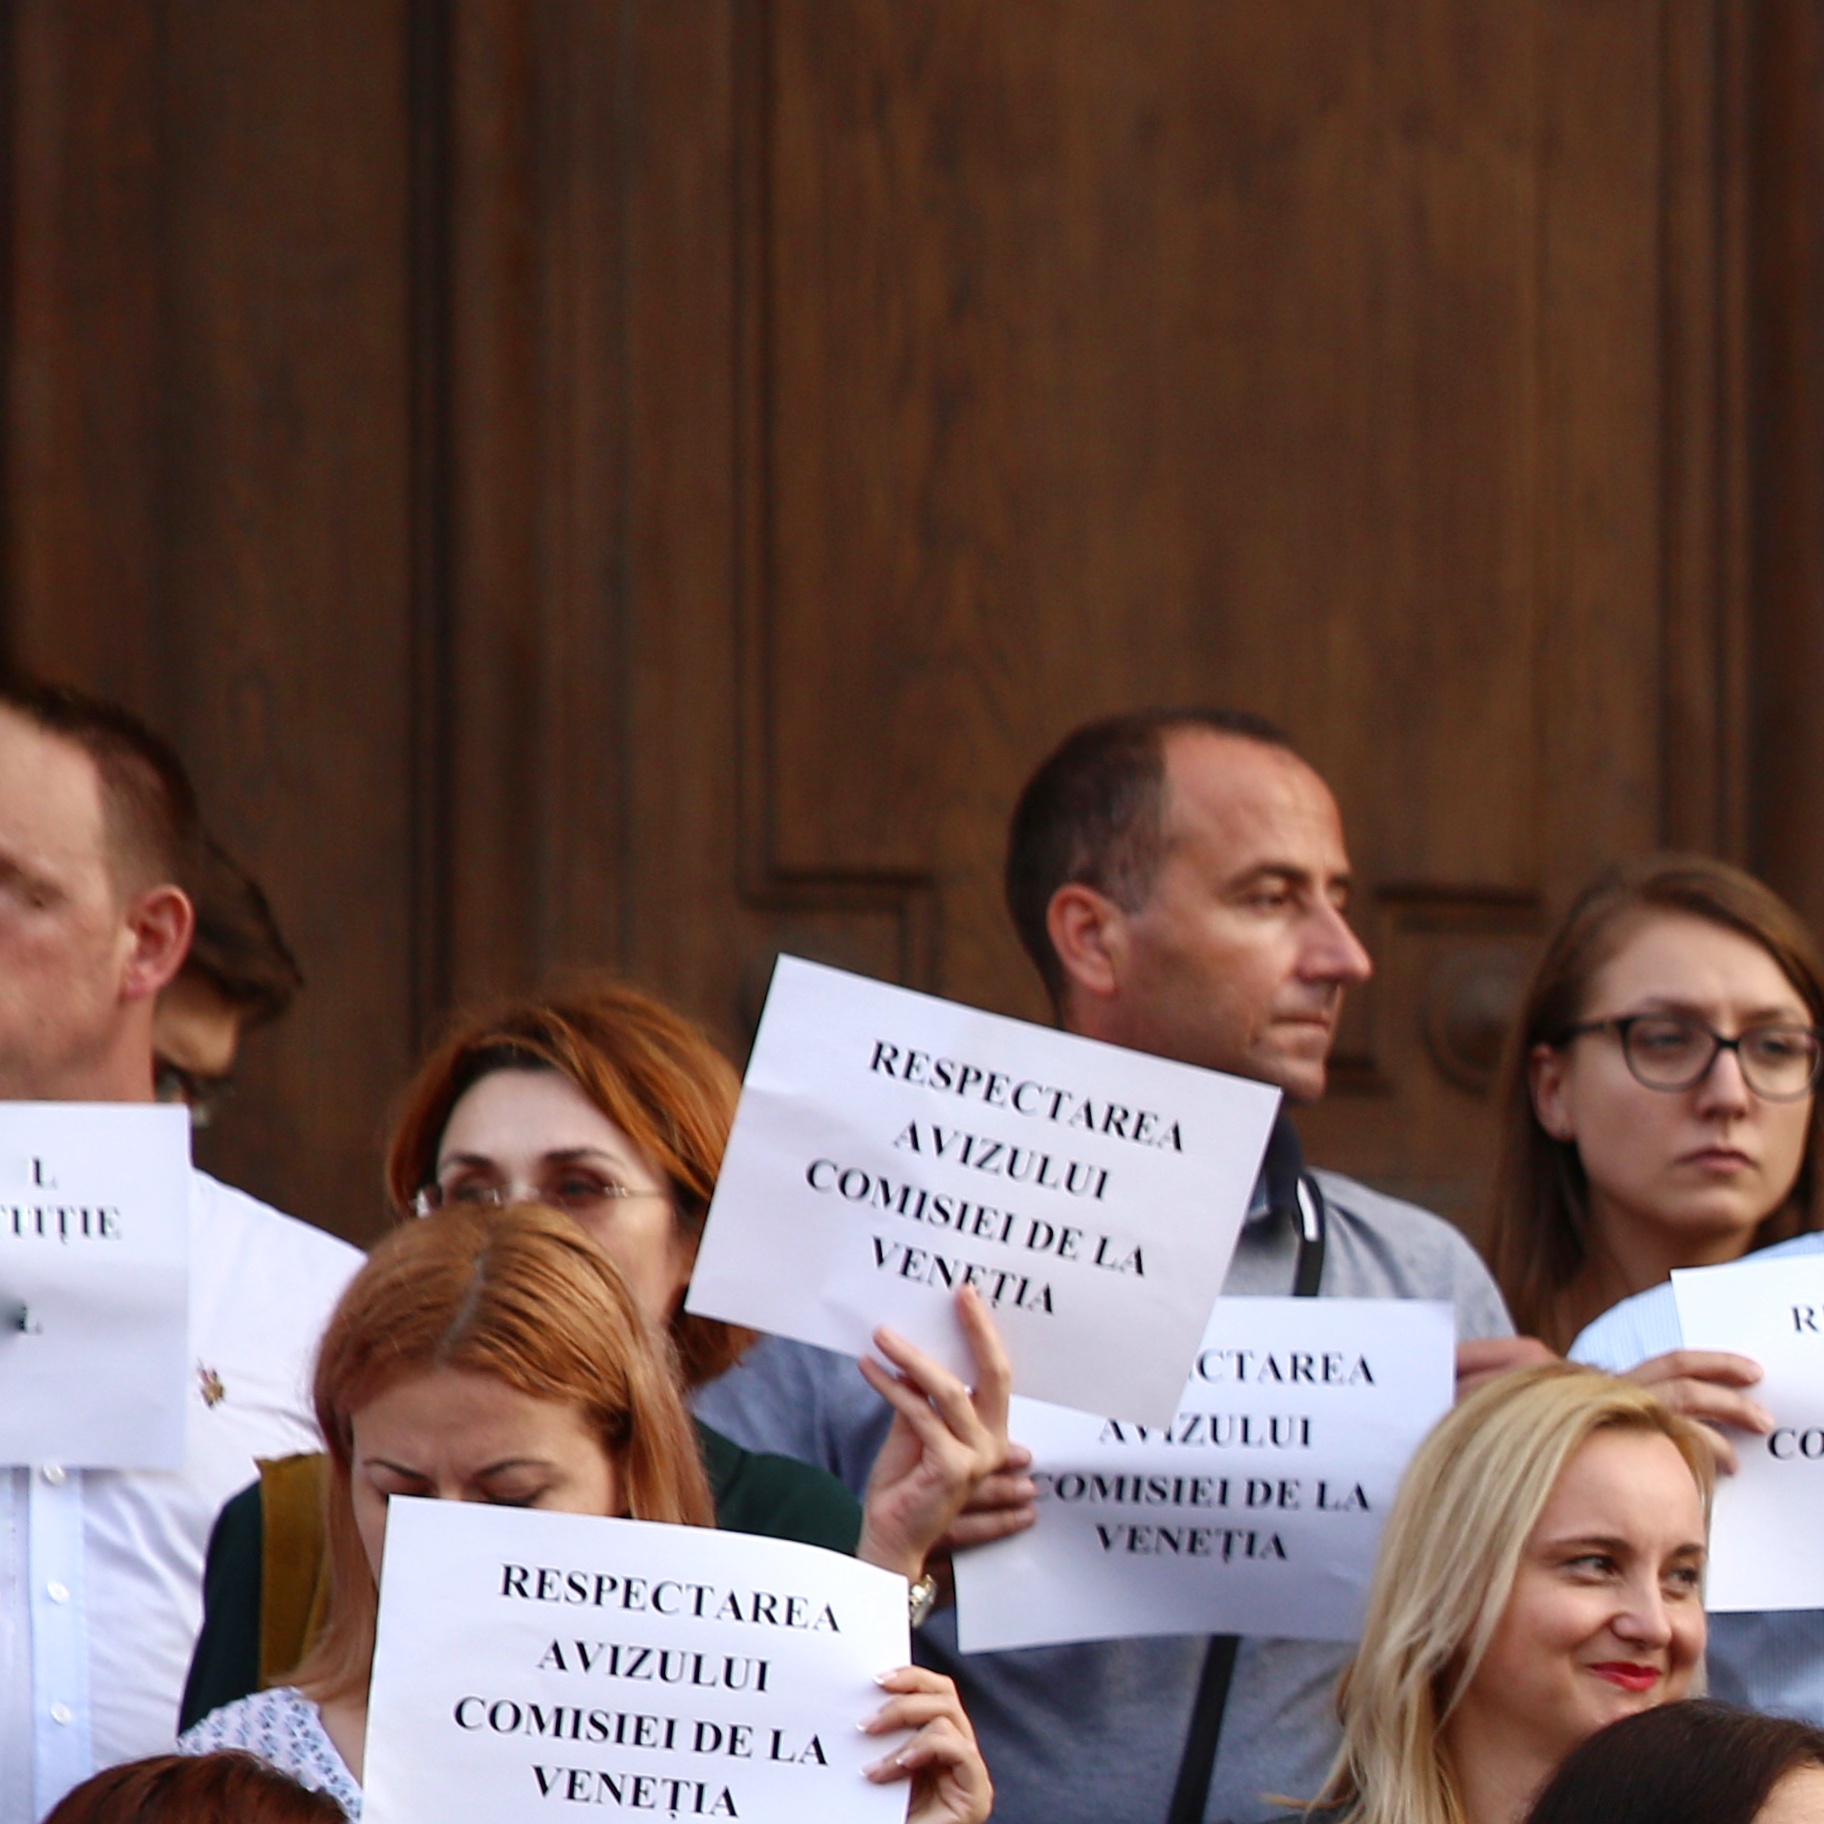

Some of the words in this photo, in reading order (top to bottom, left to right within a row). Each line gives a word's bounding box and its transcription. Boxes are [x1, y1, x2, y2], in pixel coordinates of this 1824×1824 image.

[868, 1038, 1186, 1154] RESPECTAREA
[893, 1119, 1111, 1201] AVIZULUI
[805, 1158, 1015, 1243] COMISIEI
[1026, 1220, 1083, 1260] DE
[1092, 1236, 1146, 1277] LA
[1186, 1350, 1375, 1385] CTAREA
[1245, 1479, 1301, 1511] DE
[1315, 1480, 1371, 1513] LA
[1095, 1524, 1289, 1564] VENEȚIA
[499, 1563, 843, 1634] RESPECTAREA
[537, 1638, 771, 1693] AVIZULUI
[453, 1696, 678, 1750] COMISIEI
[693, 1721, 754, 1758] DE
[769, 1730, 829, 1767] LA
[531, 1765, 739, 1819] VENEȚIA
